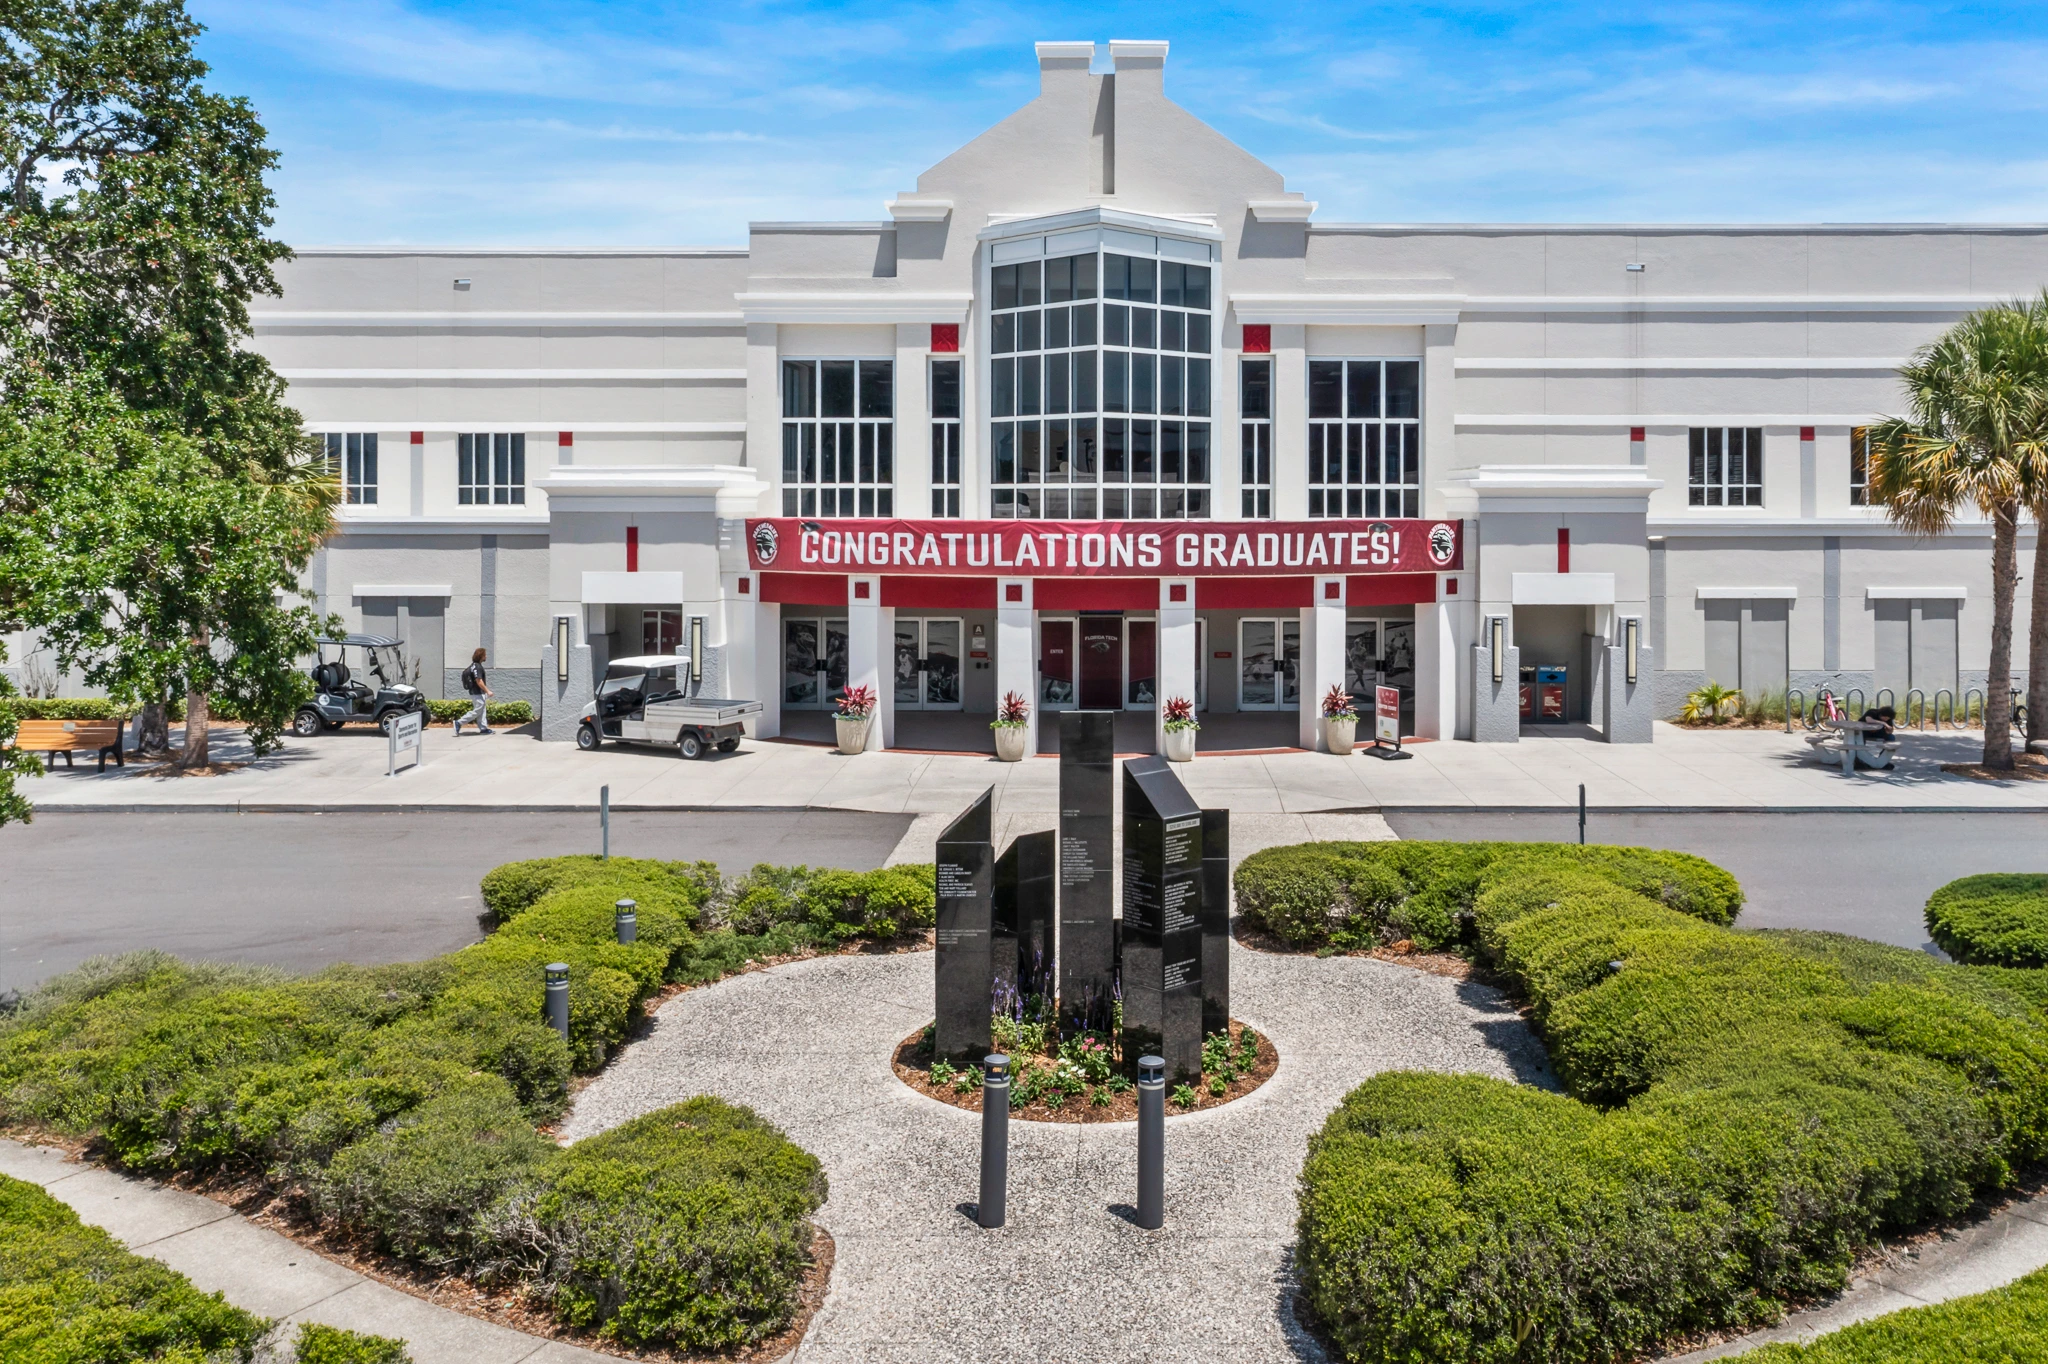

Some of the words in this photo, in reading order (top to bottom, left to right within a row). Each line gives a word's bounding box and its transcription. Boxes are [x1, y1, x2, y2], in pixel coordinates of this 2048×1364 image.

[800, 530, 1162, 567] CONGRATULATIONS
[1174, 529, 1400, 567] GRADUATES!
[975, 625, 982, 633] A
